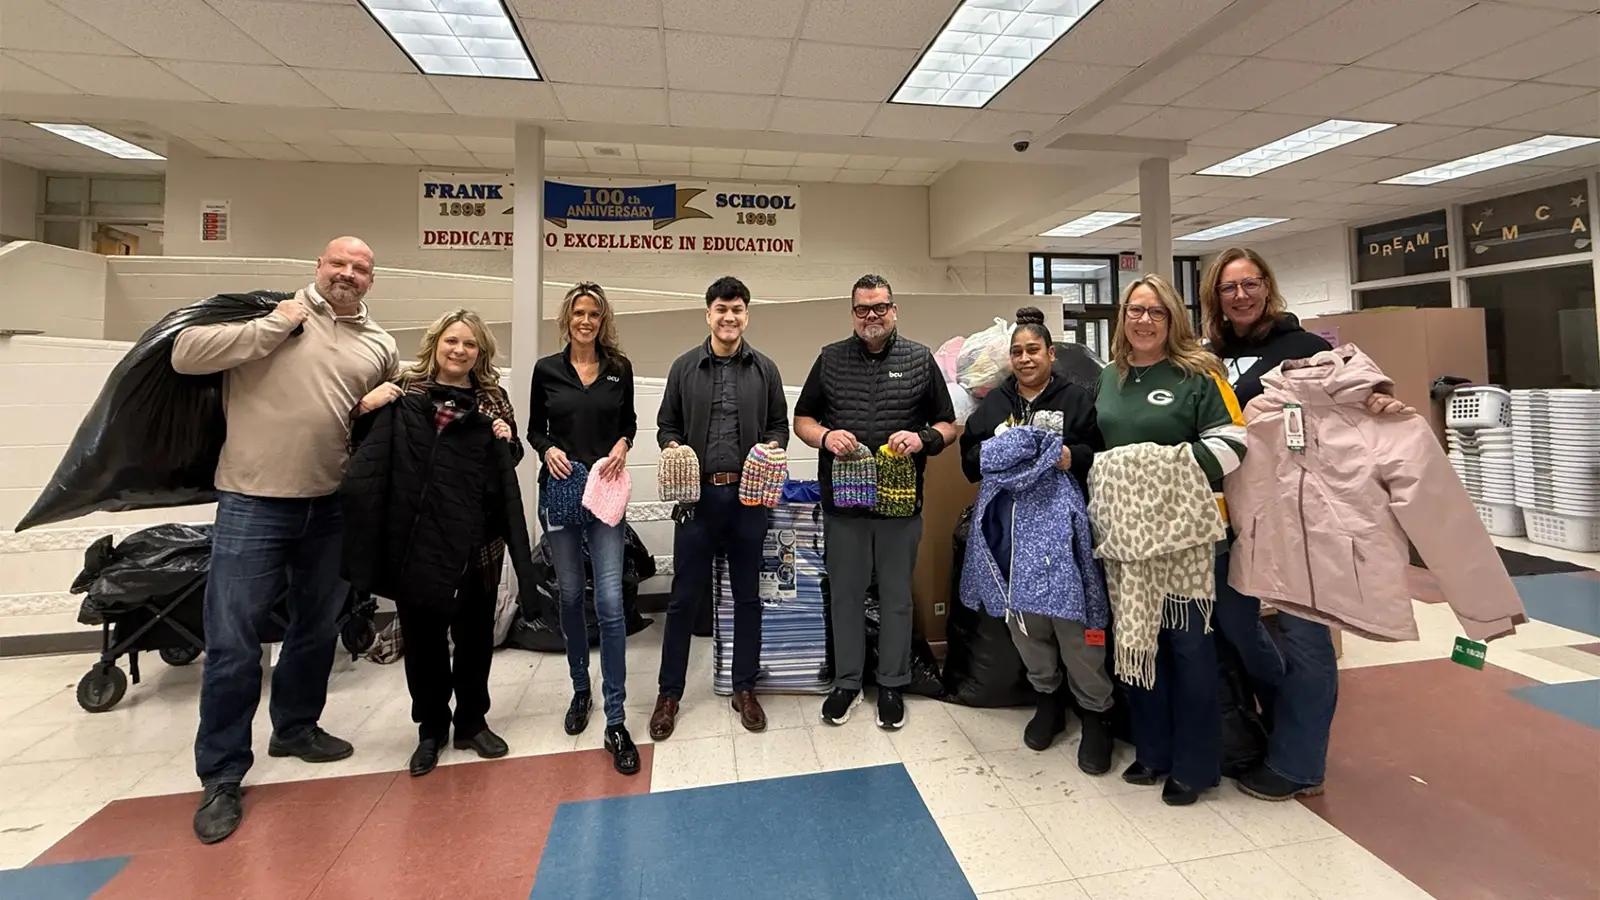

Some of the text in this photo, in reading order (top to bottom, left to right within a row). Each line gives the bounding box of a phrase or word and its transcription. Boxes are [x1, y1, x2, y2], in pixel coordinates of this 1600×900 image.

[423, 182, 504, 200] FRANK
[583, 188, 641, 205] 100 th
[439, 202, 486, 217] 1895
[715, 193, 796, 210] SCHOOL
[566, 205, 655, 218] ANNIVERSARY
[736, 211, 777, 226] 1995
[423, 230, 794, 253] DEDICATE O EXCELLENCE IN EDUCATION
[1369, 231, 1450, 260] DREAM IT
[1120, 256, 1136, 270] EXIT
[1147, 388, 1175, 406] G
